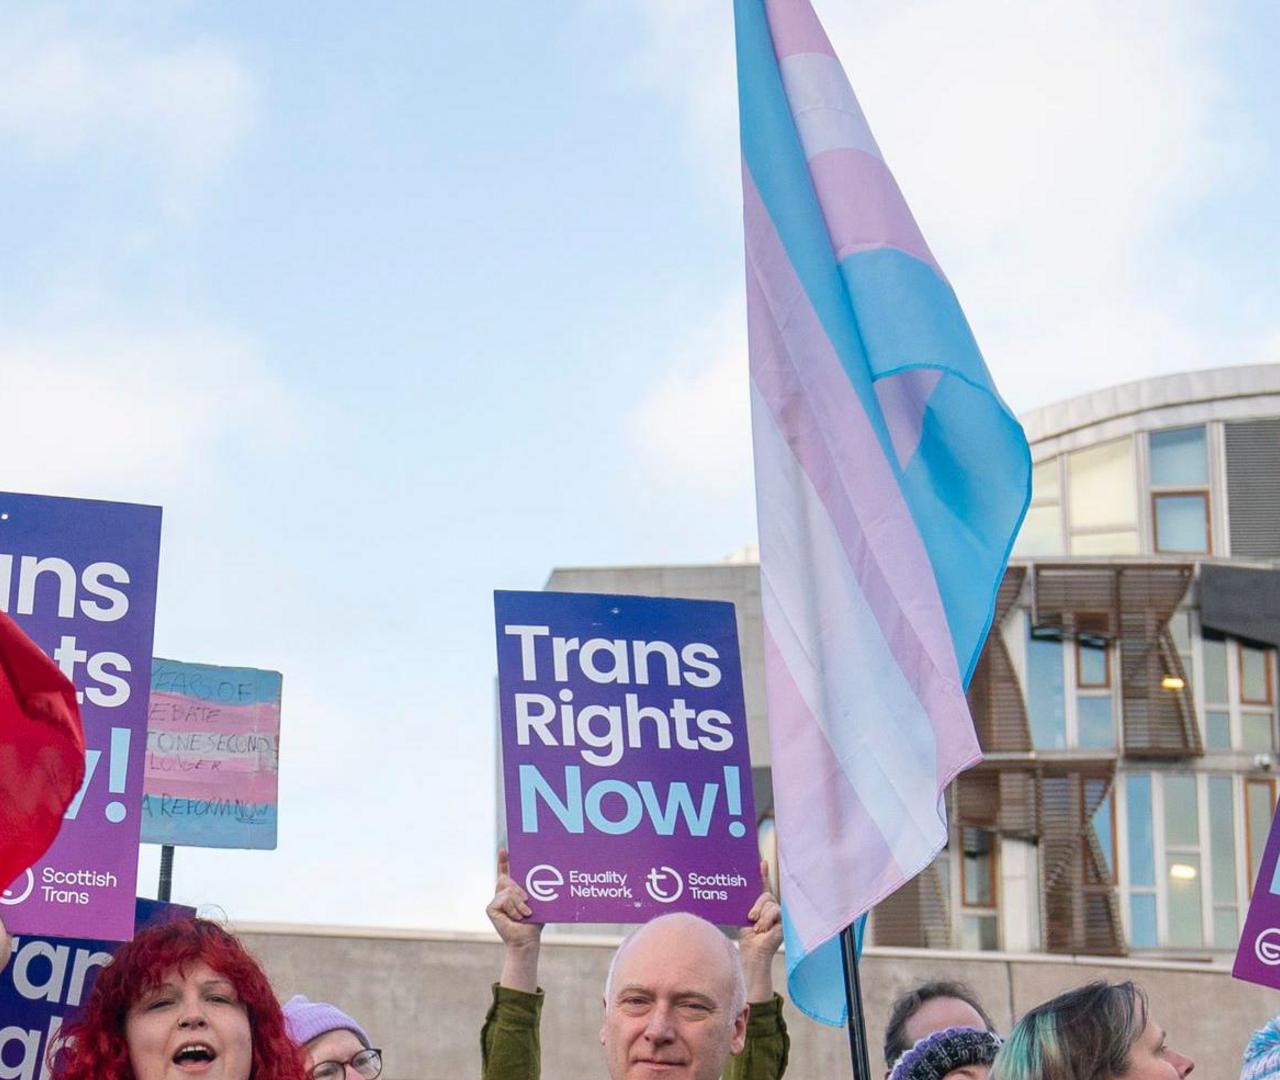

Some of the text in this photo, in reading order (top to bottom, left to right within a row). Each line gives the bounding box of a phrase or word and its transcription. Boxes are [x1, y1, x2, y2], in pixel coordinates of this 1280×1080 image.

[504, 624, 722, 688] Trans
[150, 703, 222, 723] EBATE
[514, 688, 734, 767] Rights
[518, 764, 746, 838] Now!
[41, 866, 118, 888] Scottish
[569, 870, 627, 886] Equality
[688, 872, 747, 887] Scottish
[41, 885, 90, 905] Trans
[570, 884, 632, 899] Network
[689, 886, 728, 900] Trans
